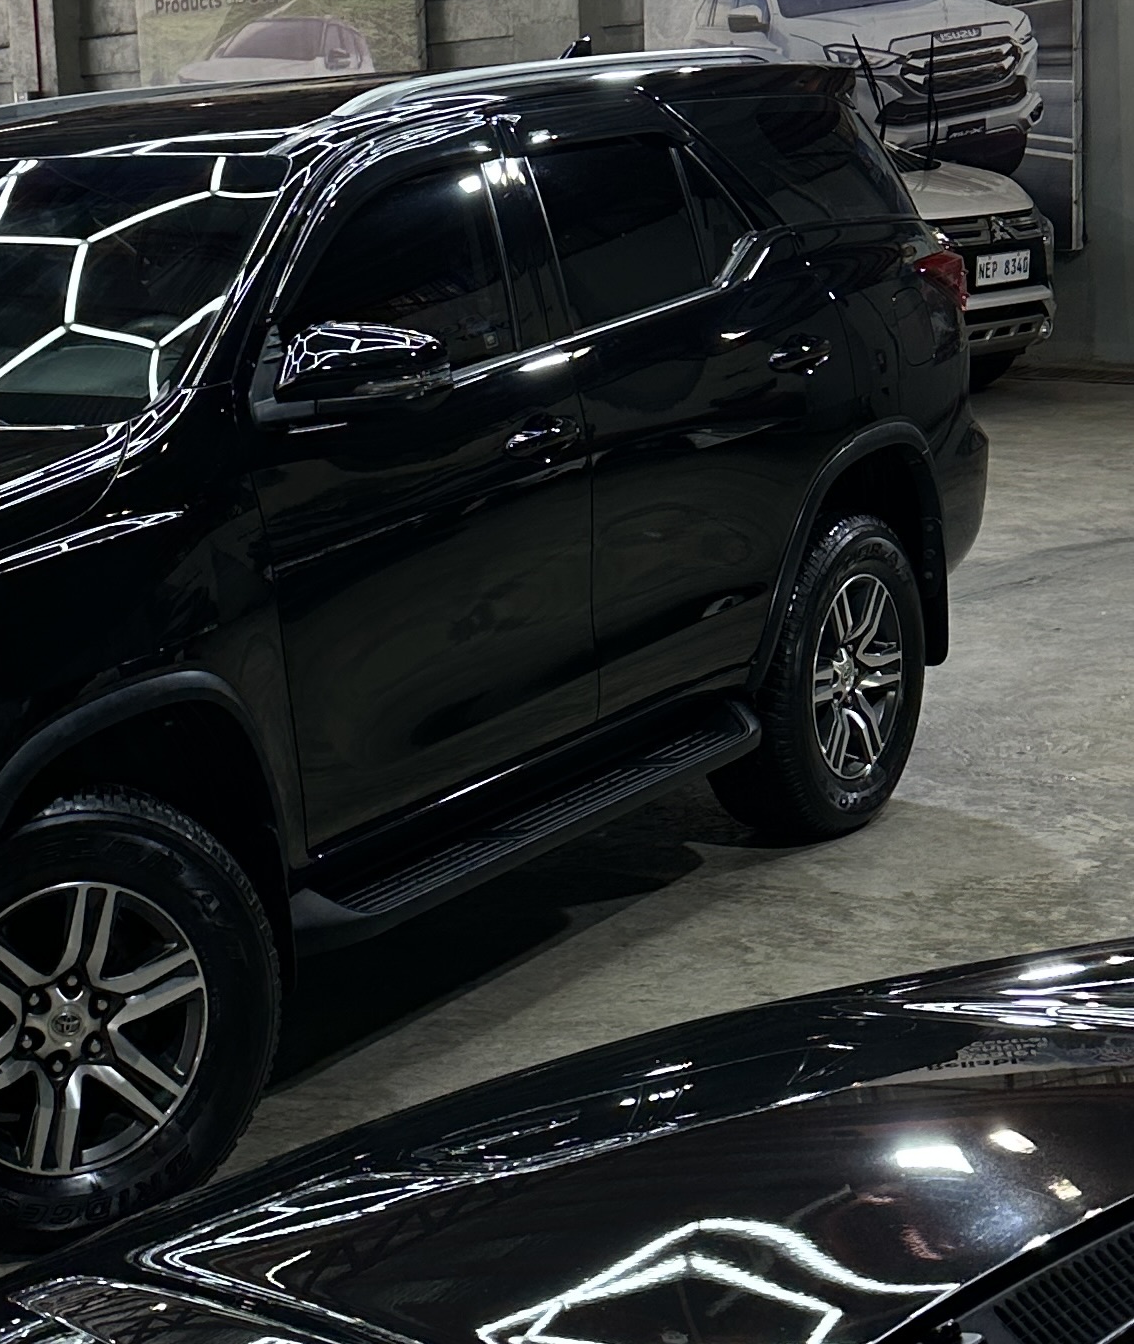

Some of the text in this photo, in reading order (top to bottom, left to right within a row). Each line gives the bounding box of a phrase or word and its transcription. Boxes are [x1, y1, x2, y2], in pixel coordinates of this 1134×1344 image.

[939, 28, 977, 42] ISUZU
[978, 256, 1028, 279] NEP 8340
